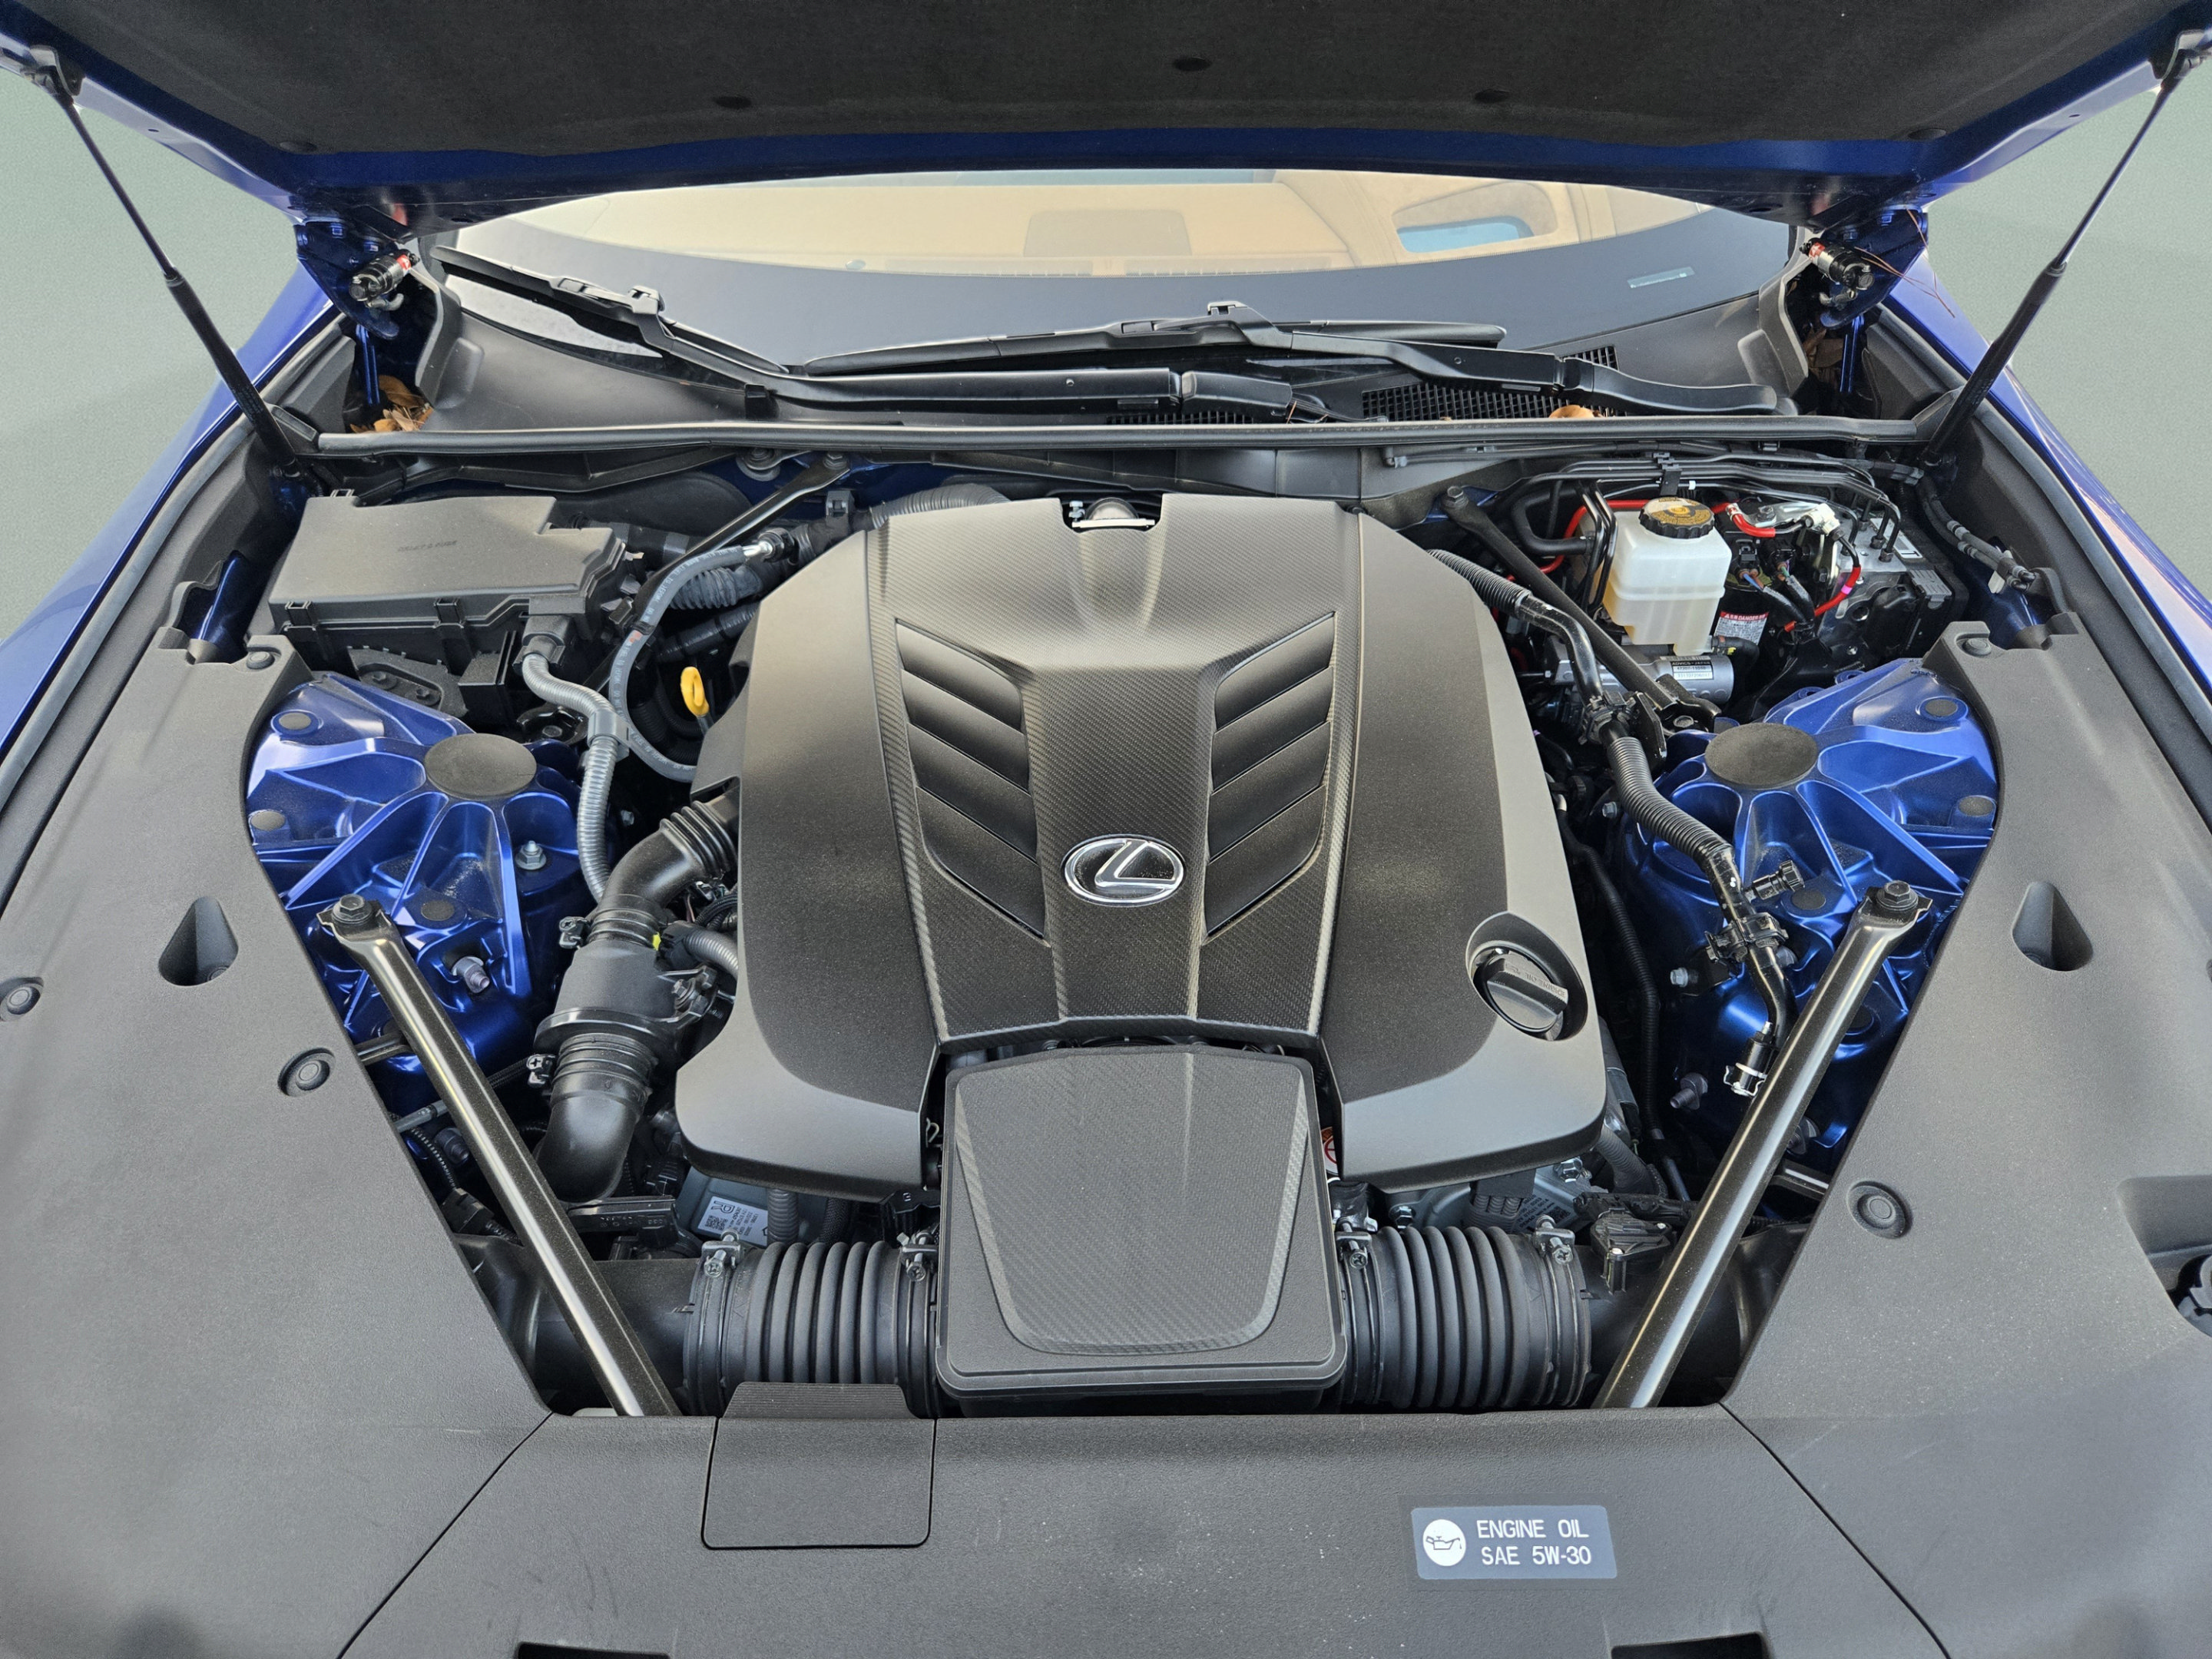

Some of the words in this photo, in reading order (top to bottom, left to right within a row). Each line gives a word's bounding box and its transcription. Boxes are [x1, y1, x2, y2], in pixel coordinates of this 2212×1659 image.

[1476, 1519, 1546, 1538] ENGINE
[1558, 1519, 1590, 1538] OIL
[1481, 1546, 1521, 1565] SAE
[1532, 1545, 1592, 1565] 5W-30
